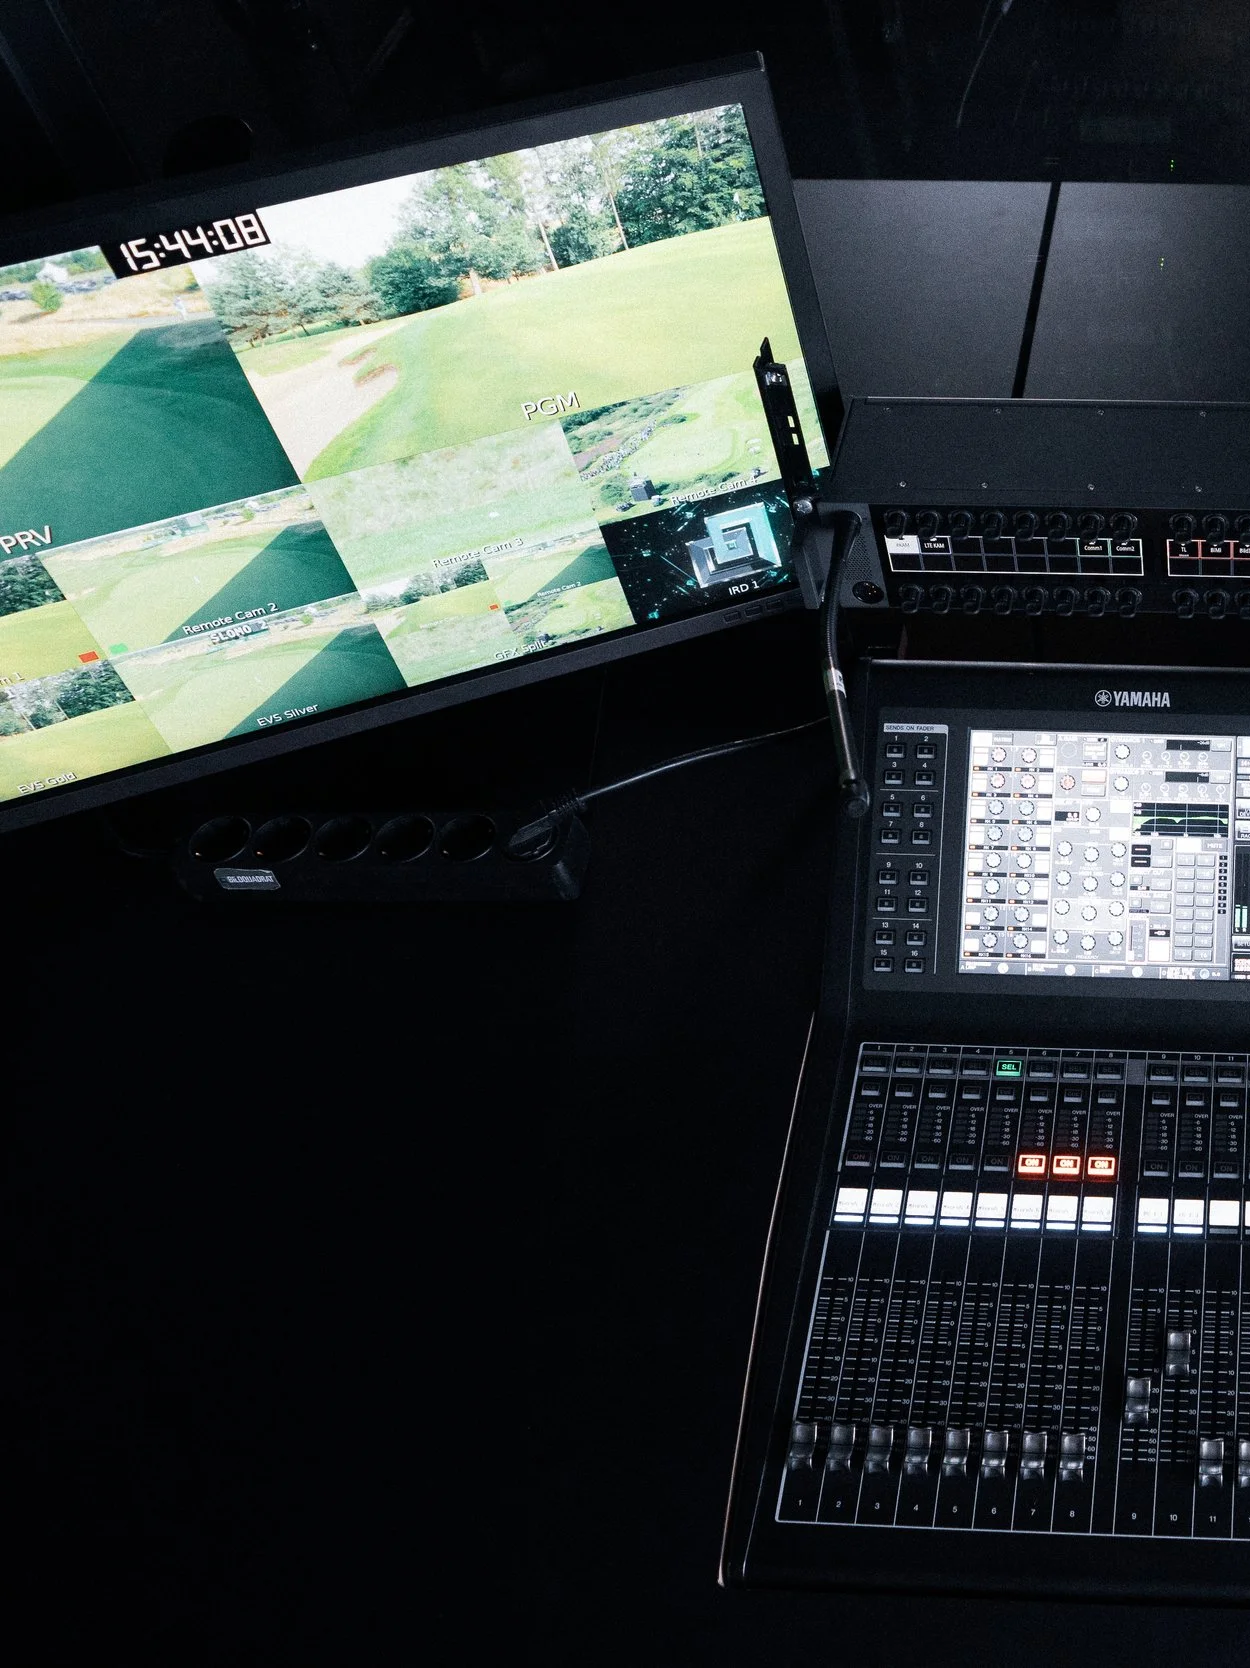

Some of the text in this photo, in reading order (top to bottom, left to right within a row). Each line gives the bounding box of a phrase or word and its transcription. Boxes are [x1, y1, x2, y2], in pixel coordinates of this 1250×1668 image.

[120, 213, 266, 271] 15:44:08
[522, 392, 581, 421] PGM
[670, 486, 717, 504] Remote
[718, 479, 746, 495] Cam
[0, 525, 52, 554] PRV
[433, 537, 524, 568] Remote Cam 3
[729, 581, 760, 596] IRD 1
[182, 602, 279, 635] Remote Cam 2
[259, 619, 269, 630] 2
[494, 638, 549, 661] GFX Split
[1113, 691, 1171, 708] YAMAHA
[257, 703, 319, 728] EVS Silver
[17, 771, 77, 795] EVS Gold
[881, 921, 889, 929] 13
[880, 948, 888, 956] 15
[911, 949, 919, 957] 16
[1001, 1063, 1017, 1071] SEL
[1025, 1157, 1040, 1167] ON
[1060, 1158, 1075, 1168] ON
[1095, 1160, 1109, 1169] ON
[835, 1500, 842, 1508] 2
[874, 1502, 880, 1510] 3
[952, 1505, 958, 1514] 5
[991, 1507, 997, 1515] 6
[1031, 1508, 1036, 1516] 7
[1069, 1510, 1075, 1518] 8
[1131, 1512, 1137, 1520] 9
[1169, 1513, 1178, 1522] 10
[1209, 1515, 1217, 1523] 11
